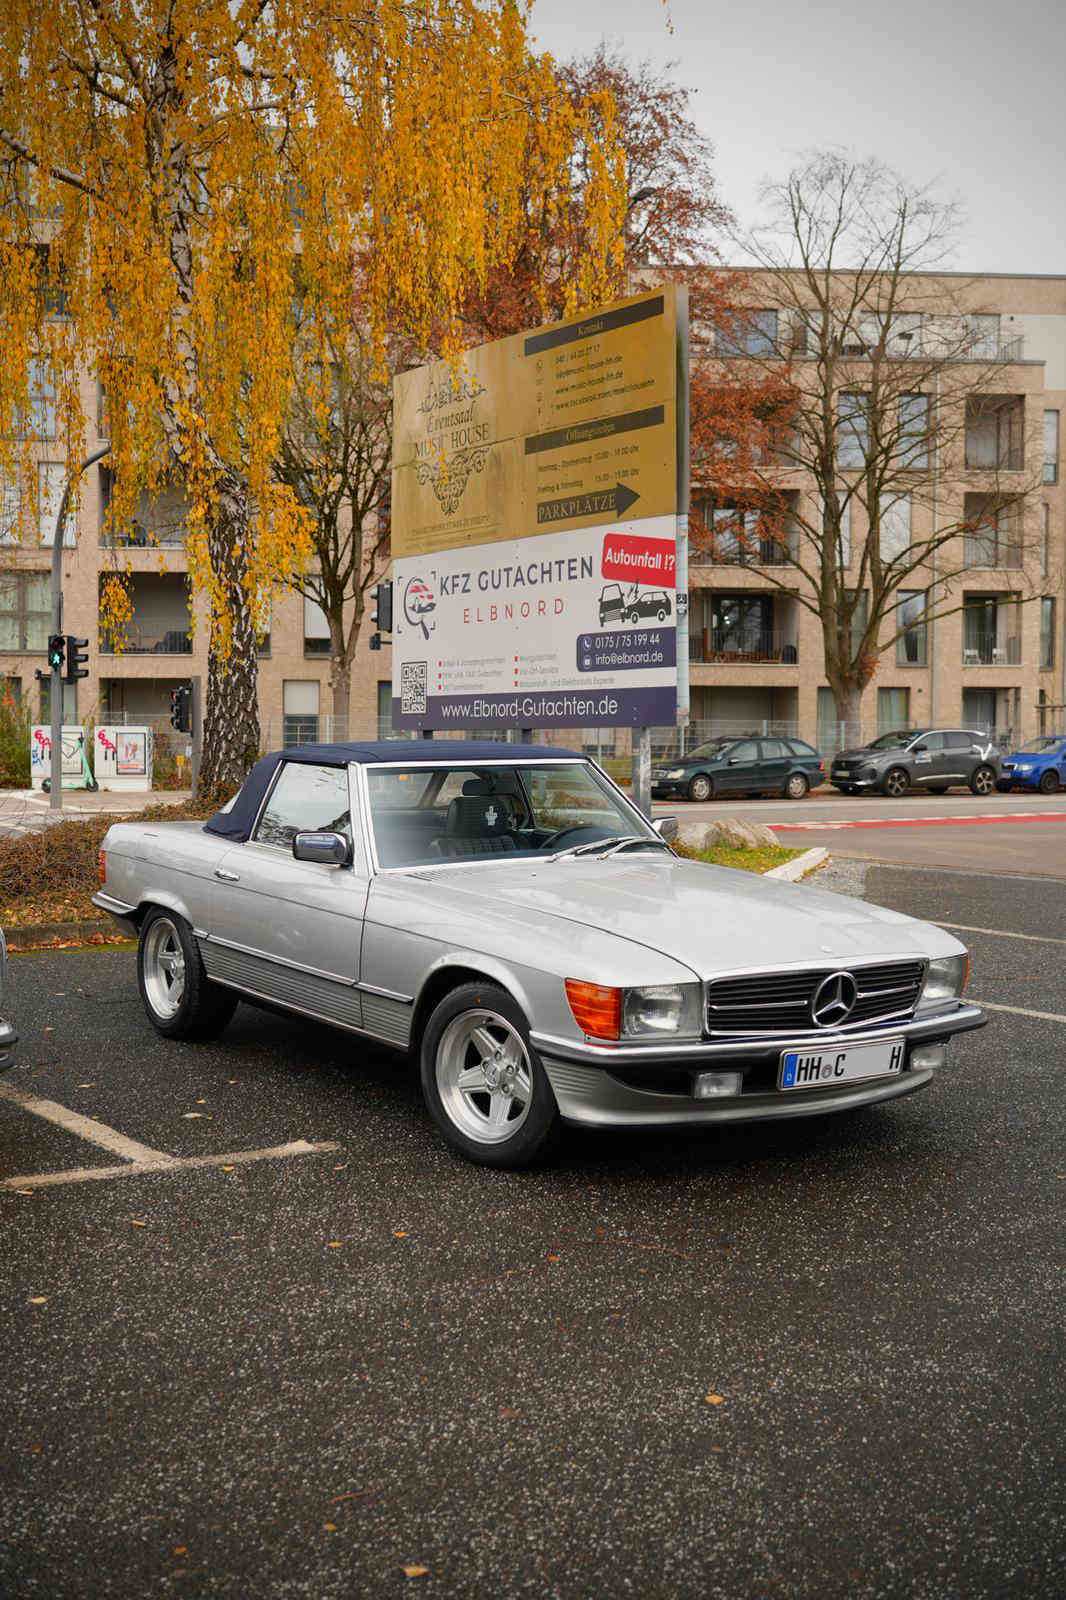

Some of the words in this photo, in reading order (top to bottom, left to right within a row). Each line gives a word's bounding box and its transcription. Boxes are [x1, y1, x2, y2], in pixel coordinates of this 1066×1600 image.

[451, 423, 489, 449] HOUSE
[538, 493, 617, 521] PARKPLÄTZE
[604, 547, 662, 569] Autounfall
[664, 553, 676, 571] !?
[440, 573, 471, 596] KFZ
[478, 556, 593, 591] GUTACHTEN
[463, 598, 564, 624] ELBNORD
[595, 635, 614, 649] 0175
[621, 635, 632, 648] 75
[633, 634, 648, 646] 199
[649, 633, 660, 645] 44
[595, 650, 664, 665] info@elbnord.de
[441, 696, 618, 718] www.Elbnord-Gutachten.de
[796, 1057, 822, 1082] HH
[834, 1053, 846, 1077] C
[889, 1046, 902, 1070] H
